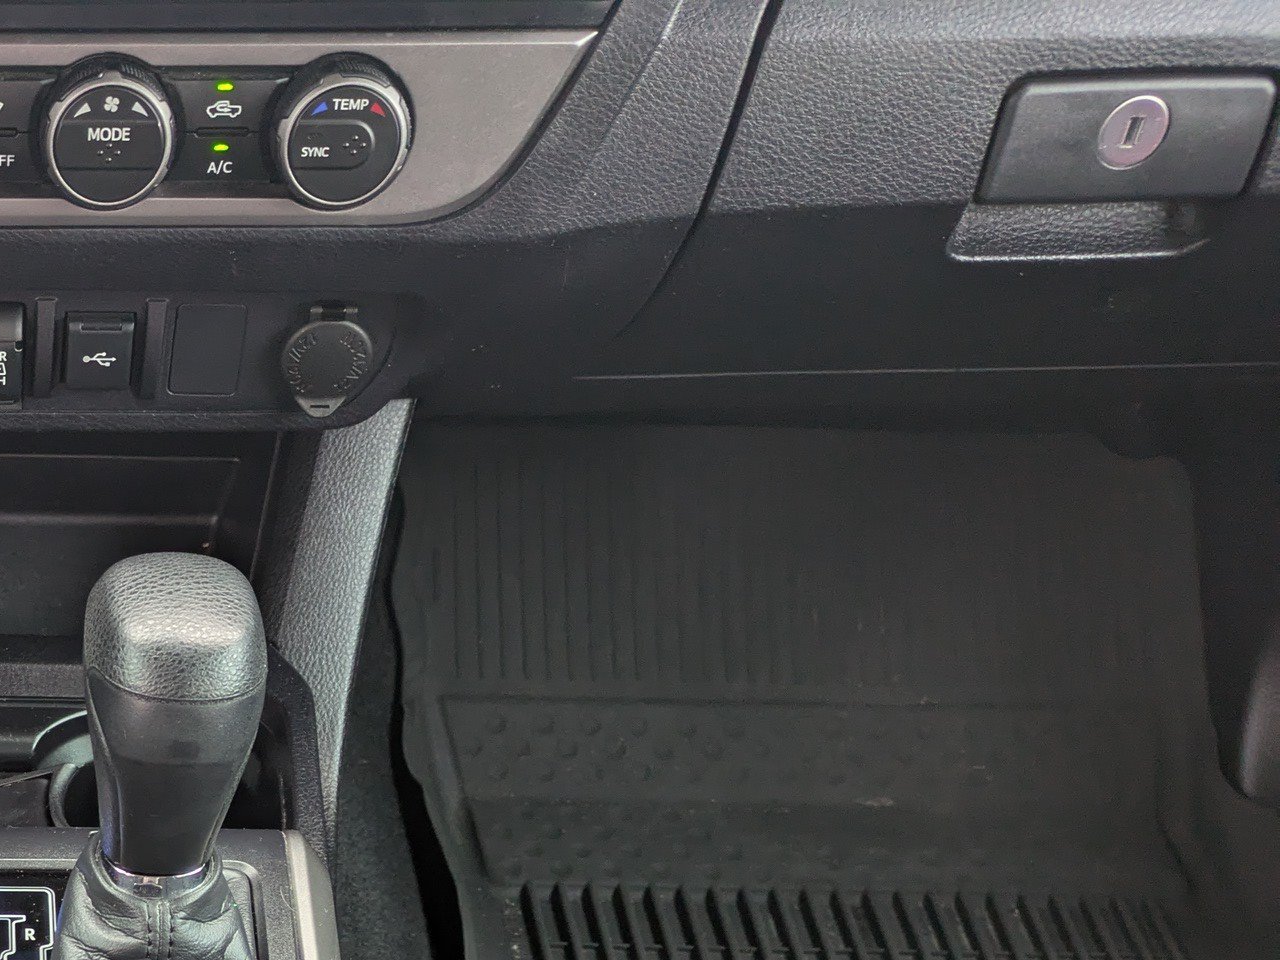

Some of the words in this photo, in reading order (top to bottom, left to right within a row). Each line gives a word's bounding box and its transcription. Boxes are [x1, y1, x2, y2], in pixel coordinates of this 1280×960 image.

[332, 99, 370, 111] TEMP
[87, 127, 131, 142] MODE
[300, 146, 330, 158] SYNC
[206, 160, 233, 175] A/C
[24, 928, 36, 941] R
